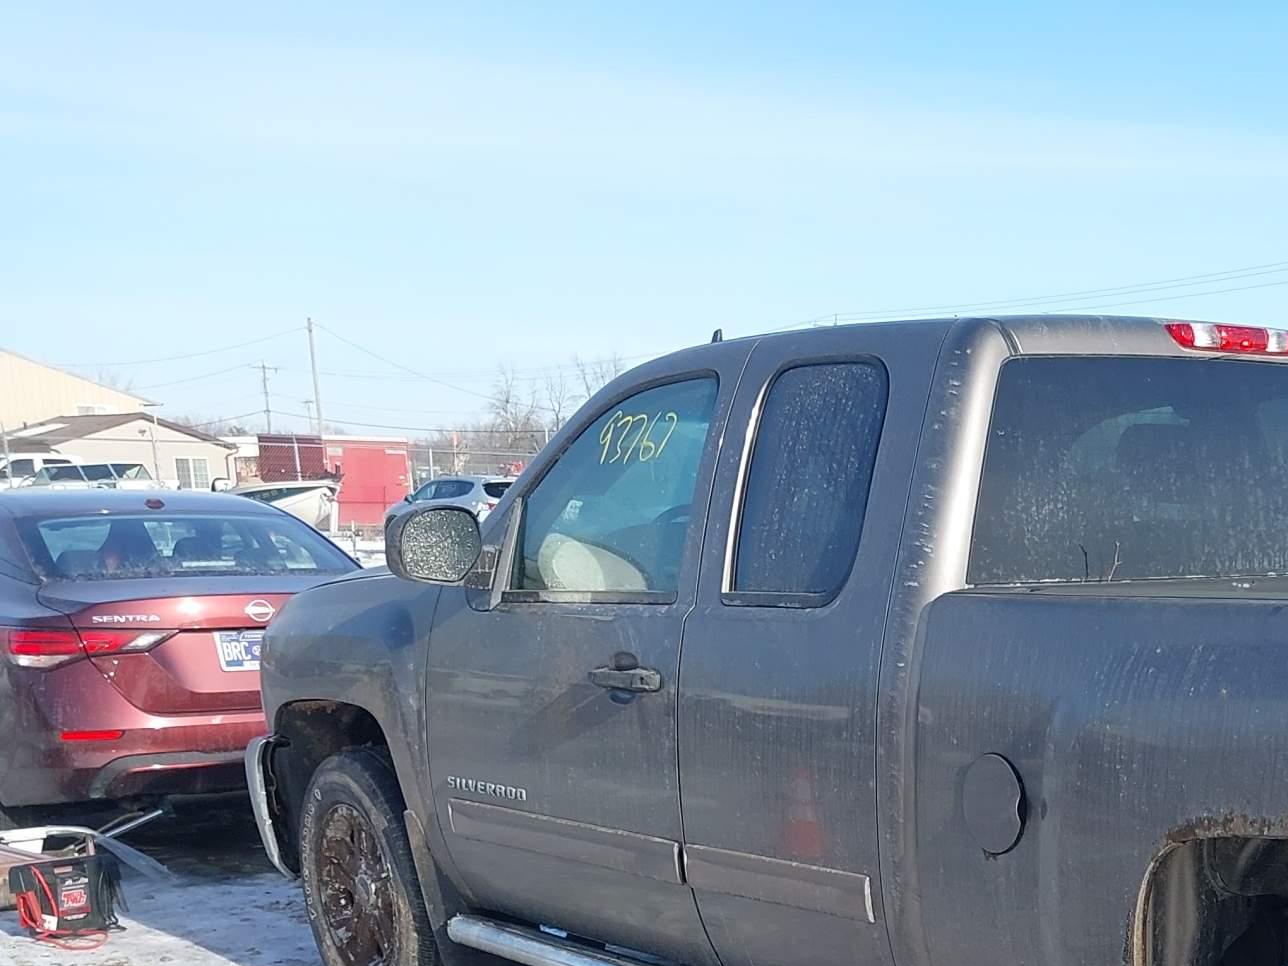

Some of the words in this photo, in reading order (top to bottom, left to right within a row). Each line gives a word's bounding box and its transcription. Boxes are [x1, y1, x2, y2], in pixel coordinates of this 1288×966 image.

[599, 410, 677, 465] 93767
[92, 615, 161, 624] SENTRA
[222, 641, 252, 661] BRC
[447, 775, 527, 801] SILVERADO
